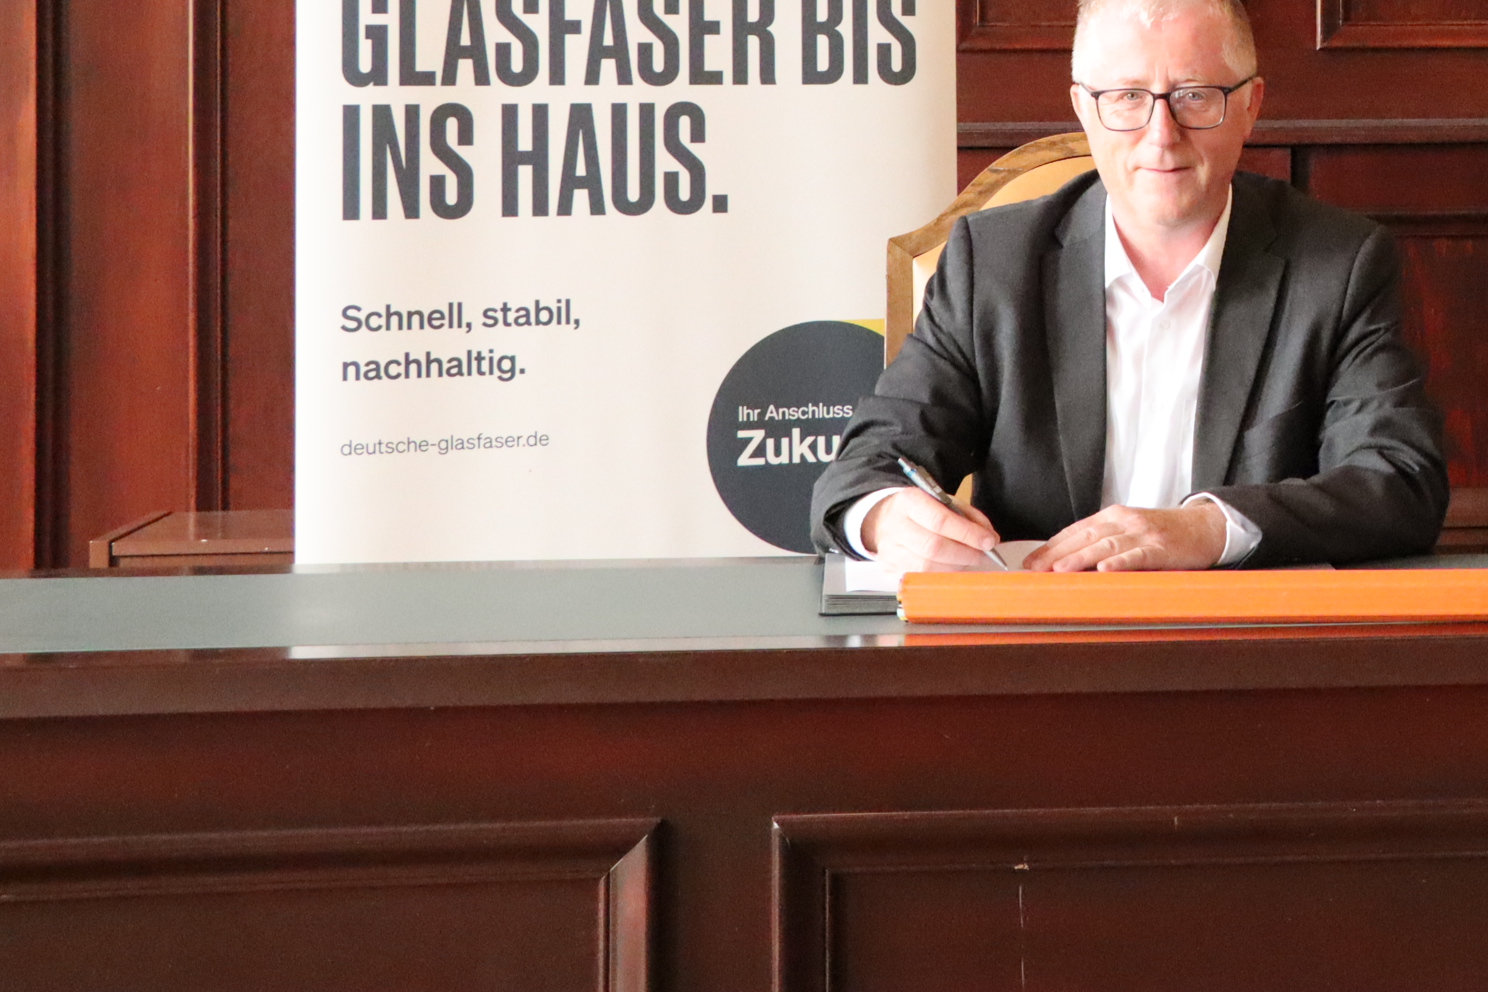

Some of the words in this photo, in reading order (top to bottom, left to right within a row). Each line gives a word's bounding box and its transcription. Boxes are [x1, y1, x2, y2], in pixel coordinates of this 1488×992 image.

[343, 102, 474, 220] INS
[501, 101, 728, 217] HAUS.
[341, 302, 472, 333] Schnell,
[482, 299, 580, 330] stabil,
[343, 349, 525, 382] nachhaltig.
[739, 406, 761, 422] Ihr
[765, 402, 853, 421] Anschluss
[341, 432, 549, 455] deutsche-glasfaser.de
